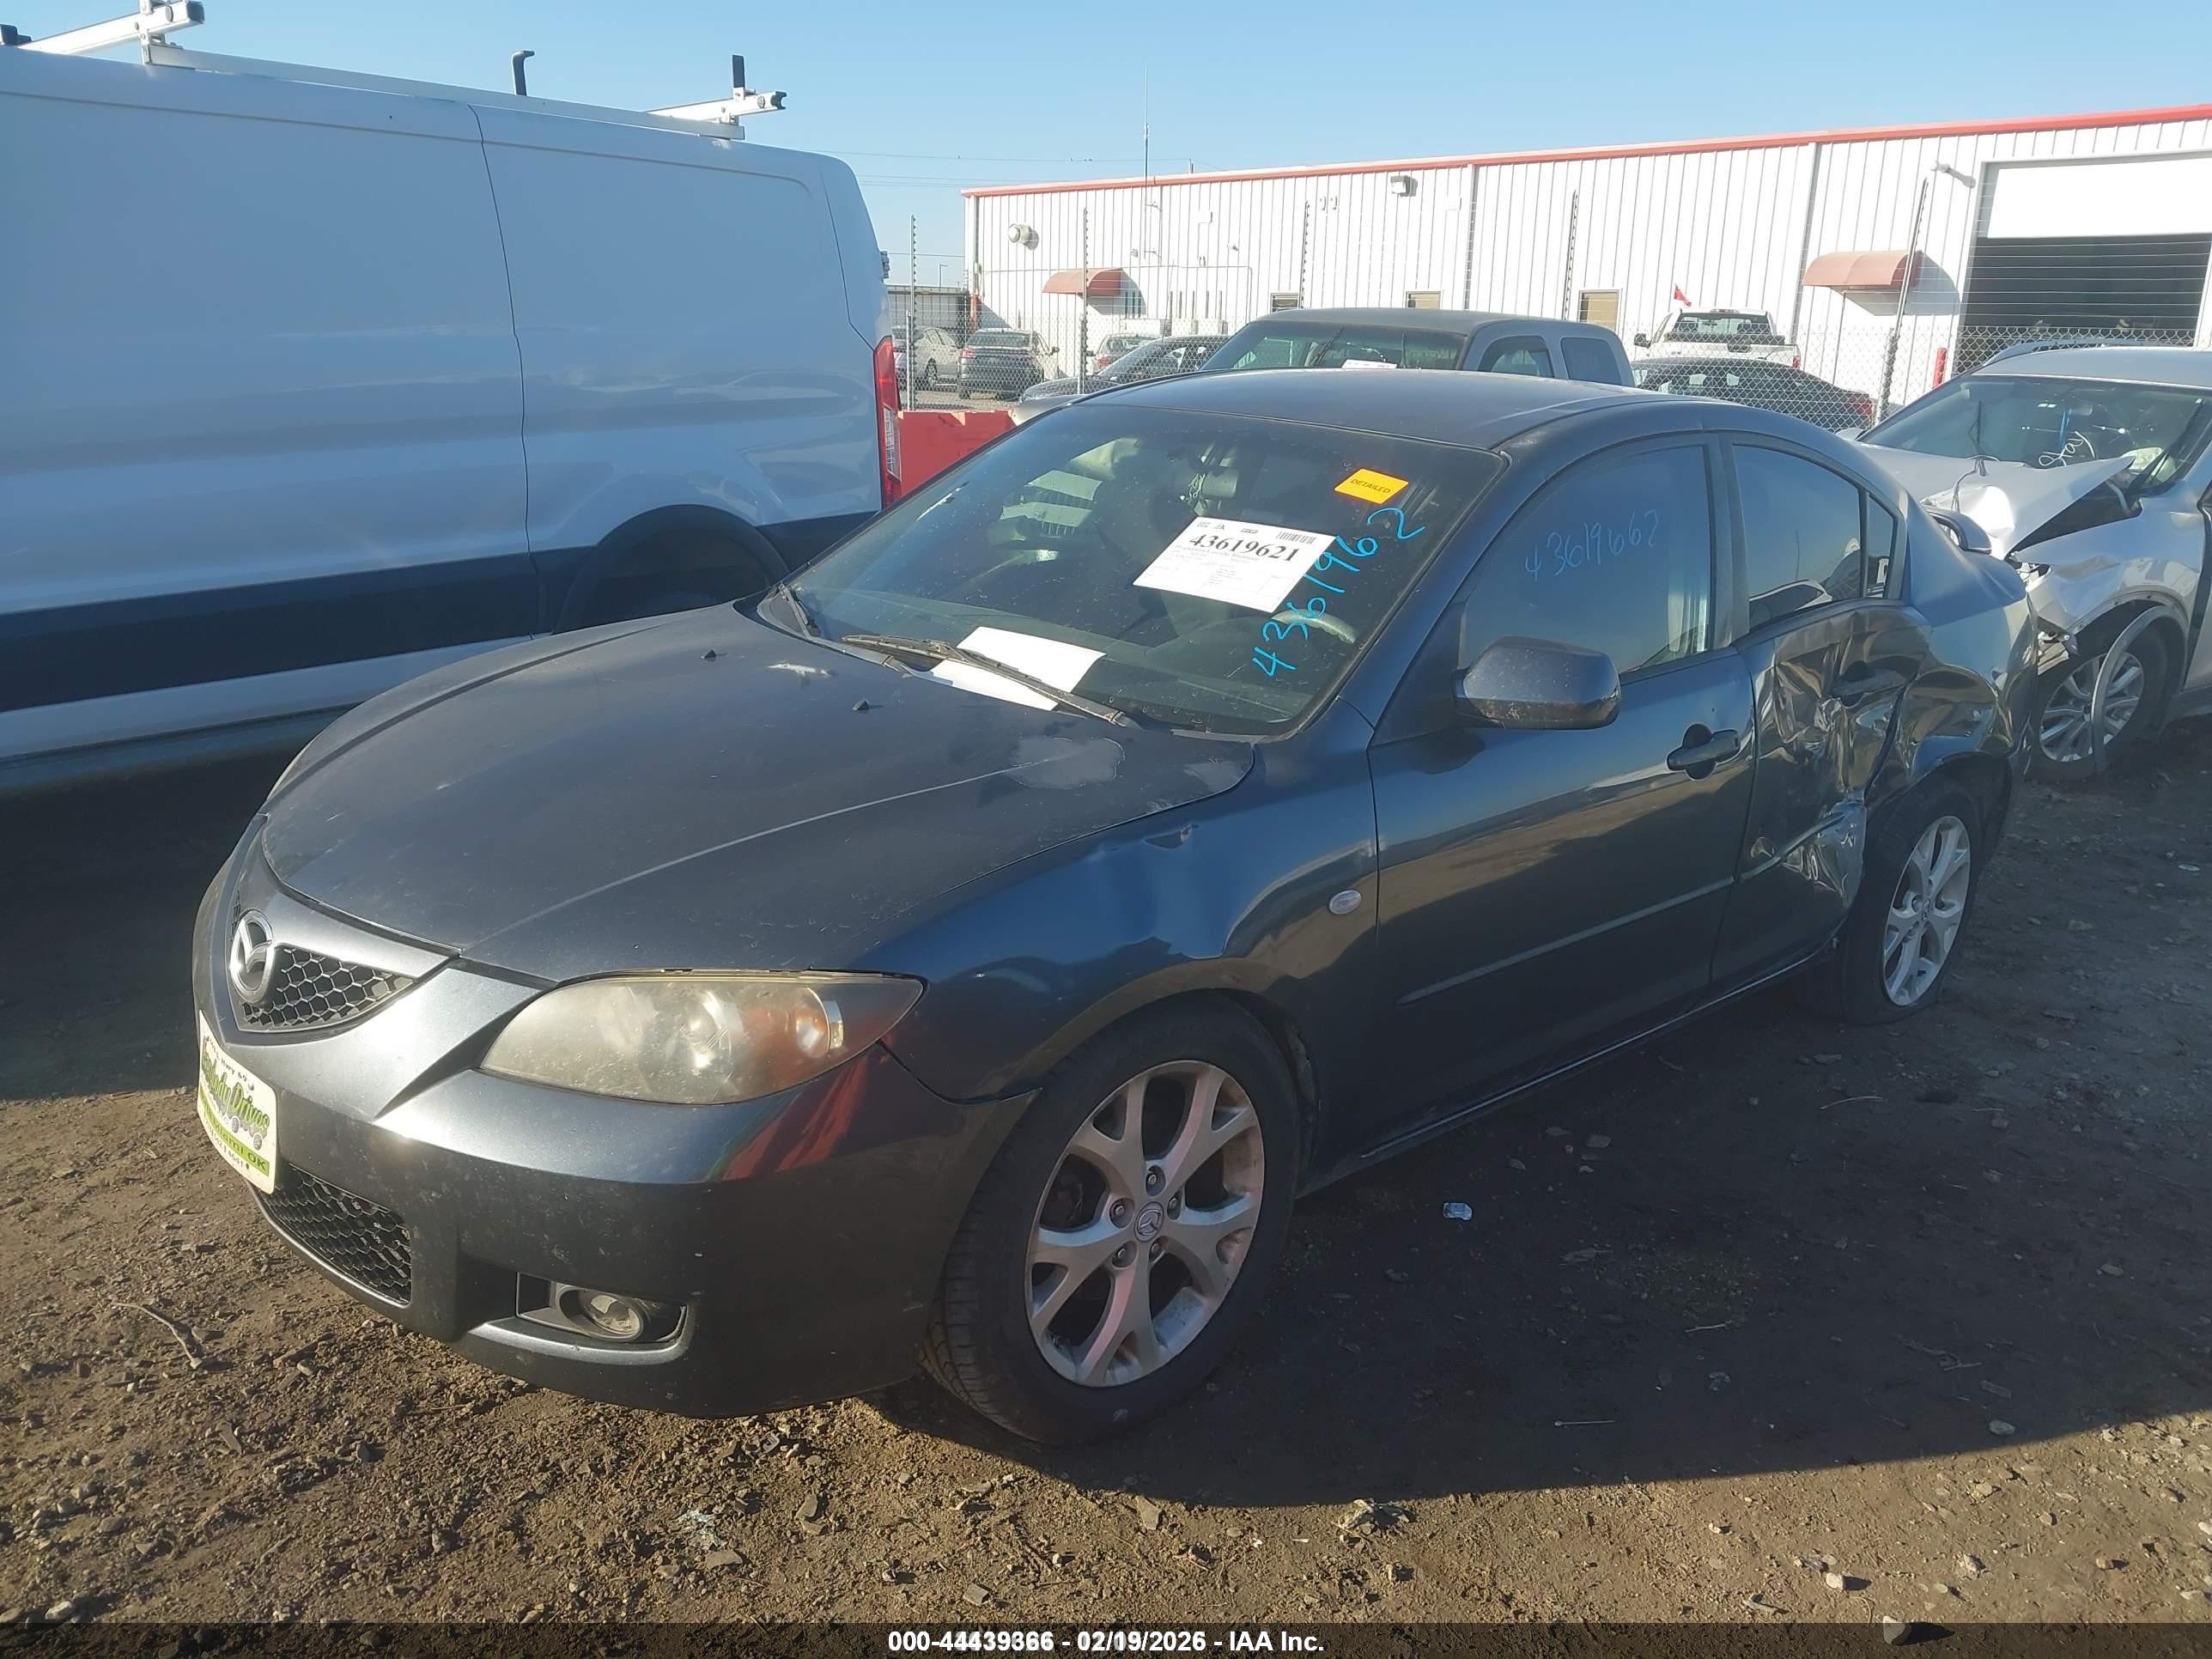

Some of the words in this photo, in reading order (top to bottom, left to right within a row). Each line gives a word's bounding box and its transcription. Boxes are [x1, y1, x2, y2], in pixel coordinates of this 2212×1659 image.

[1350, 478, 1391, 494] DETAILED
[1188, 533, 1301, 562] 43619621
[1251, 507, 1426, 678] 4361962
[247, 1152, 267, 1171] OK
